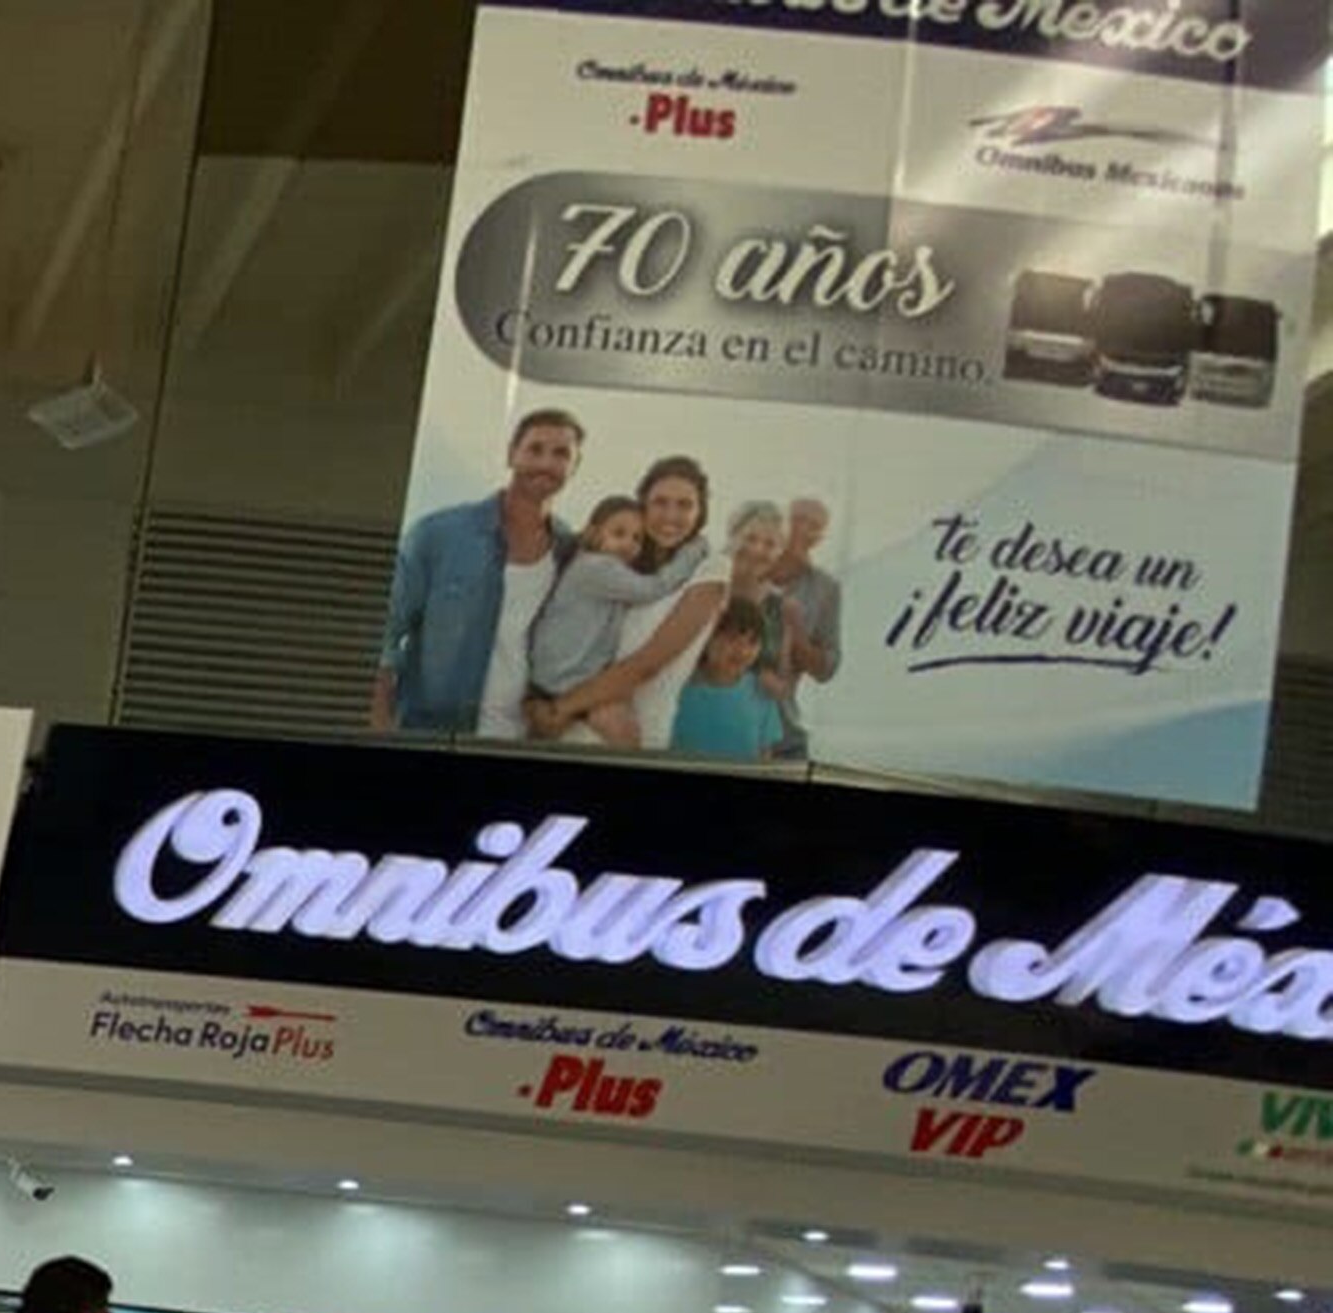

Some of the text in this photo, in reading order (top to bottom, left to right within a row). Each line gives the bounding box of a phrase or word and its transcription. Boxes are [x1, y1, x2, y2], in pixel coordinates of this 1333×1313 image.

[555, 202, 955, 318] 70 años
[494, 309, 708, 359] Confianza
[720, 332, 771, 364] en
[784, 330, 822, 368] el
[988, 520, 1126, 584] desea
[1135, 550, 1202, 592] un
[1064, 596, 1238, 675] viaje!
[112, 787, 767, 971] Omnibus
[752, 848, 977, 993] de
[90, 1010, 335, 1060] Flecha Roja Plus
[883, 1051, 1096, 1112] OMEX
[910, 1106, 1025, 1159] VIP
